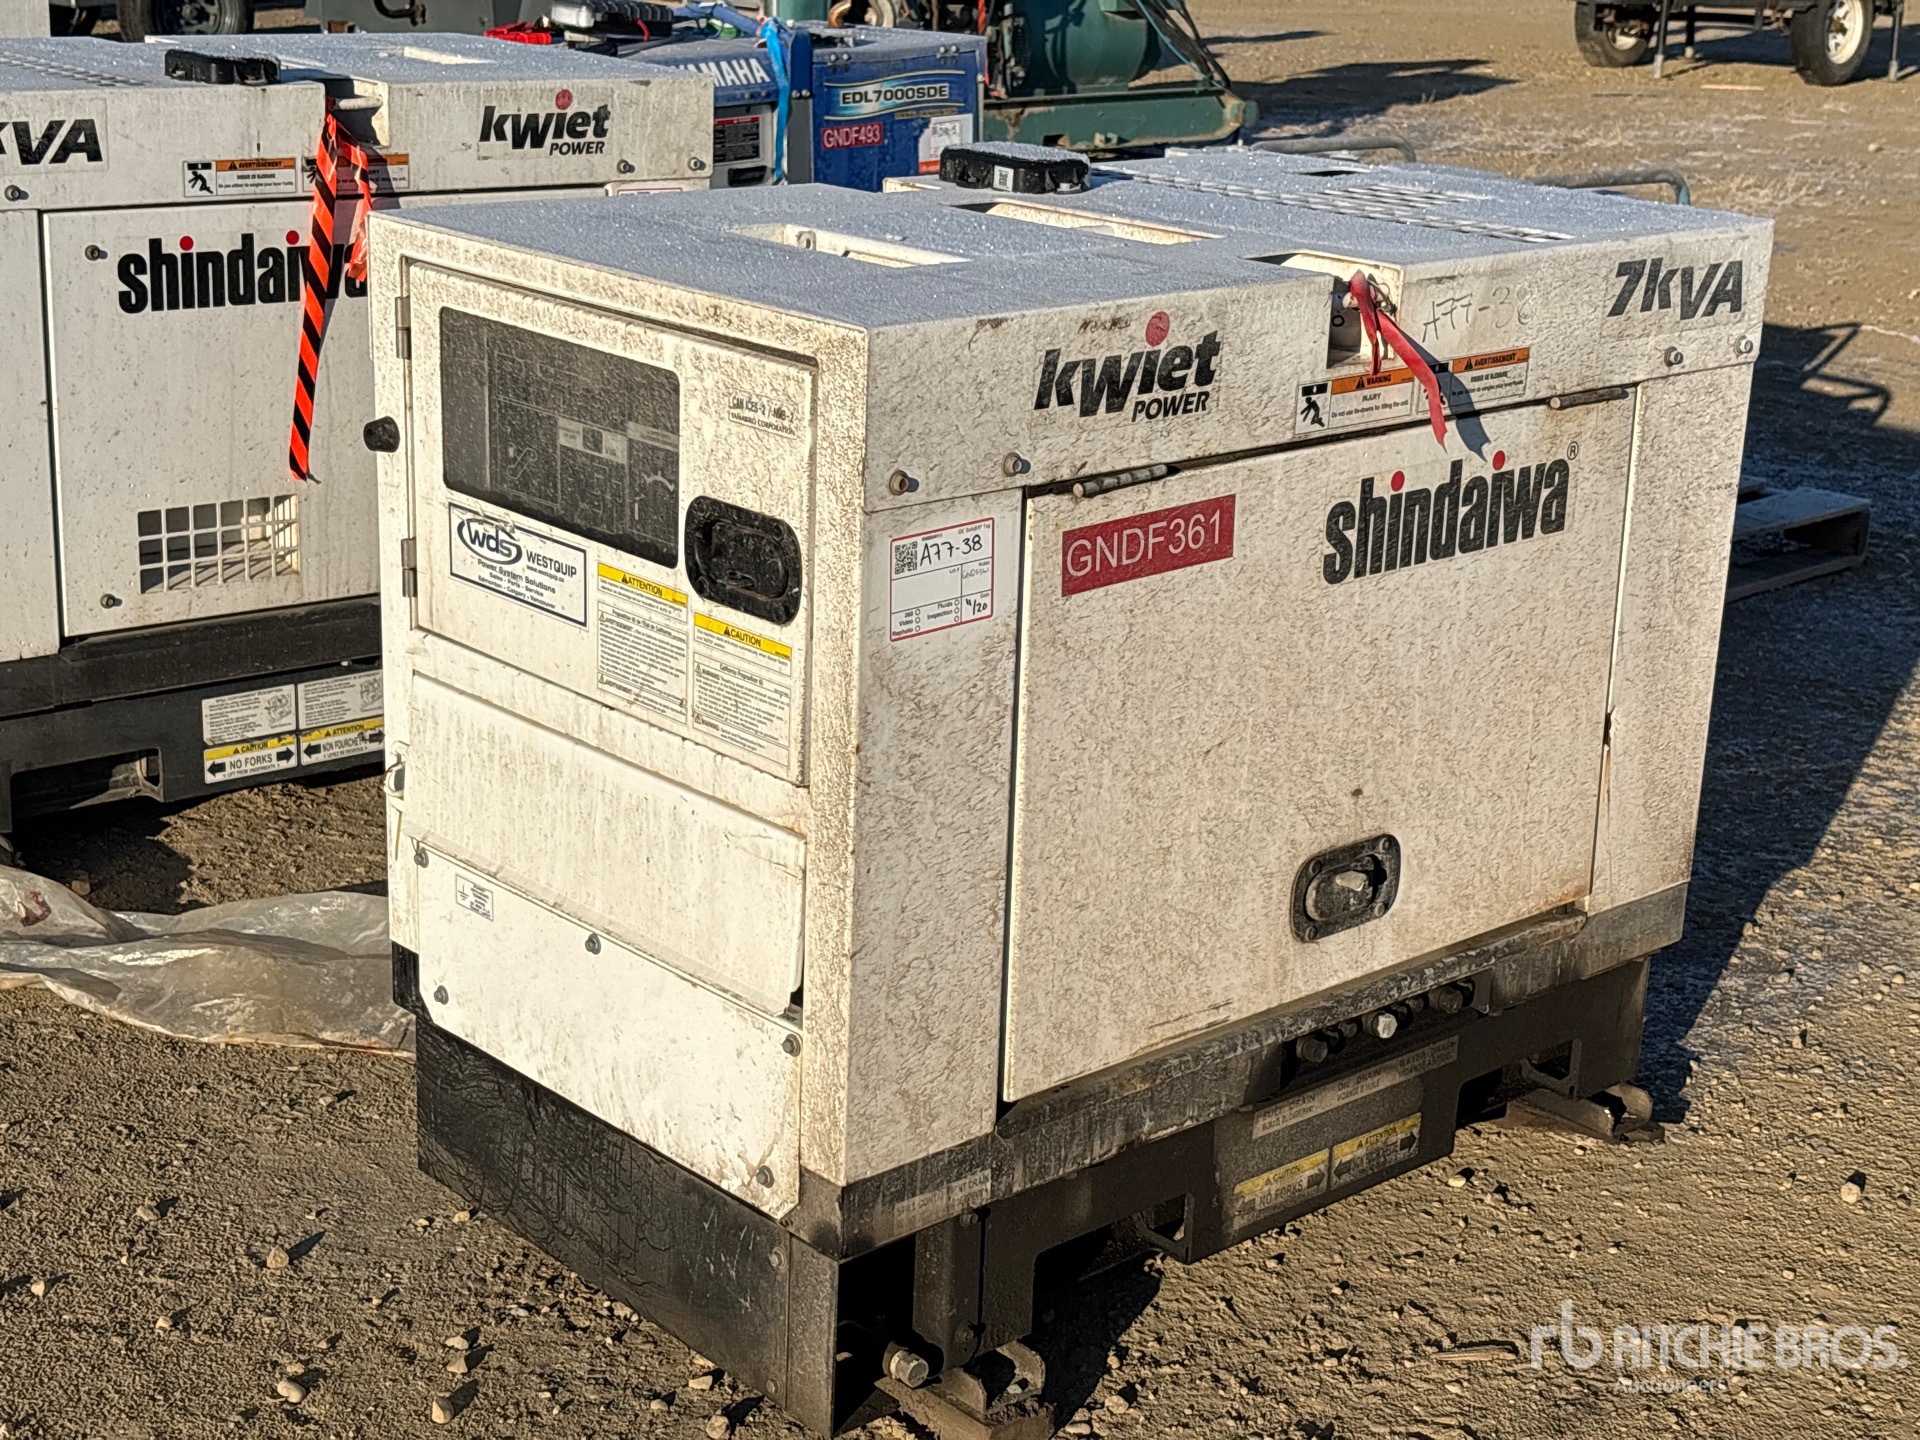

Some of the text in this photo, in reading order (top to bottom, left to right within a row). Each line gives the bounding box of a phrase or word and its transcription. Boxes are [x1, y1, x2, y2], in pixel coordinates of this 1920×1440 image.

[671, 58, 771, 88] MAHA
[842, 85, 949, 105] EDL7000SDE
[479, 89, 611, 150] kwiet
[823, 125, 881, 148] GNDF493
[549, 141, 605, 156] POWER
[1608, 257, 1742, 320] 7kVA
[1034, 311, 1222, 418] kwiet
[1474, 353, 1516, 367] AVERTISSEMENT
[1366, 374, 1392, 386] WARNING
[1131, 391, 1210, 423] POWER
[1362, 392, 1382, 402] INJURY
[1323, 450, 1570, 585] shindaiwa
[920, 534, 983, 566] A77-38
[1066, 509, 1222, 578] GNDF361
[526, 549, 577, 578] WESTQUIP
[489, 572, 544, 597] Sales Parts Service
[499, 566, 523, 582] System
[525, 576, 556, 594] Solutions
[627, 577, 663, 597] ATTENTION
[927, 609, 953, 620] Inspection
[731, 628, 762, 648] CAUTION
[333, 724, 365, 735] ATTENTION
[241, 742, 268, 753] CAUTION
[323, 735, 368, 753] NON FOURCHE
[230, 753, 273, 770] NO FORKS
[1338, 1069, 1382, 1092] OIL DRAIN
[1289, 1094, 1315, 1110] DRAIN
[1365, 1126, 1398, 1146] ATTENTION
[1273, 1165, 1302, 1184] CAUTION
[1259, 1179, 1304, 1207] NO FORKS
